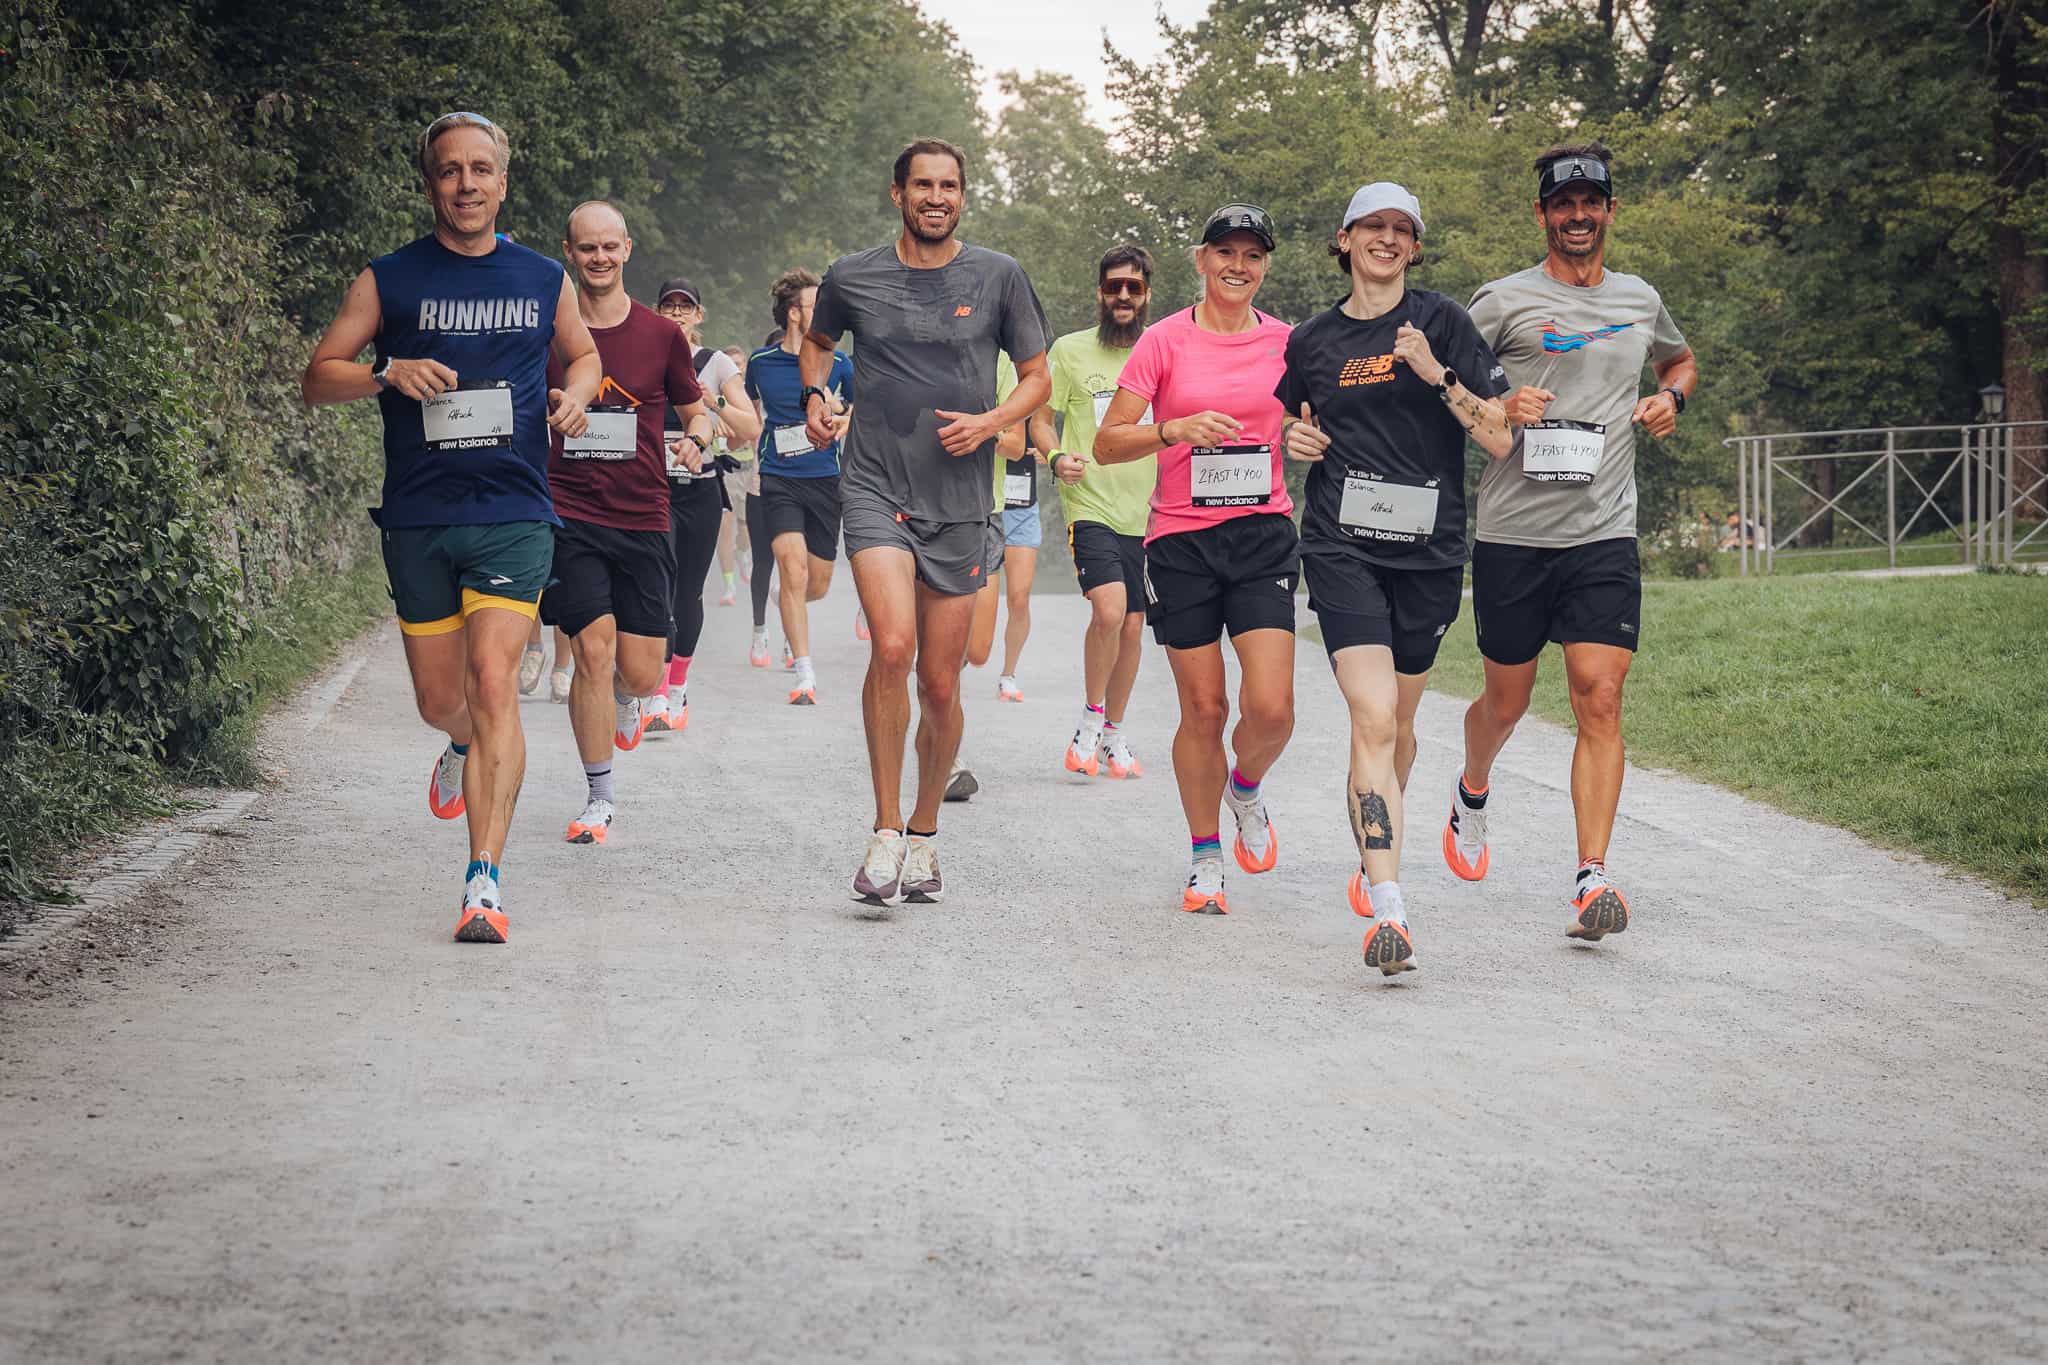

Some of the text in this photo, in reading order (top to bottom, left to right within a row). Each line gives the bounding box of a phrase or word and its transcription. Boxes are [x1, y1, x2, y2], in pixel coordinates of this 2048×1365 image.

[418, 297, 539, 330] RUNNING
[1339, 372, 1396, 388] new balance
[440, 438, 498, 450] new balance
[1580, 445, 1600, 458] YOU
[1233, 467, 1240, 481] 4
[1244, 468, 1263, 481] YOU
[1537, 472, 1591, 482] new balance
[1205, 497, 1259, 506] new balance
[1353, 527, 1375, 538] new
[1375, 530, 1416, 543] balance
